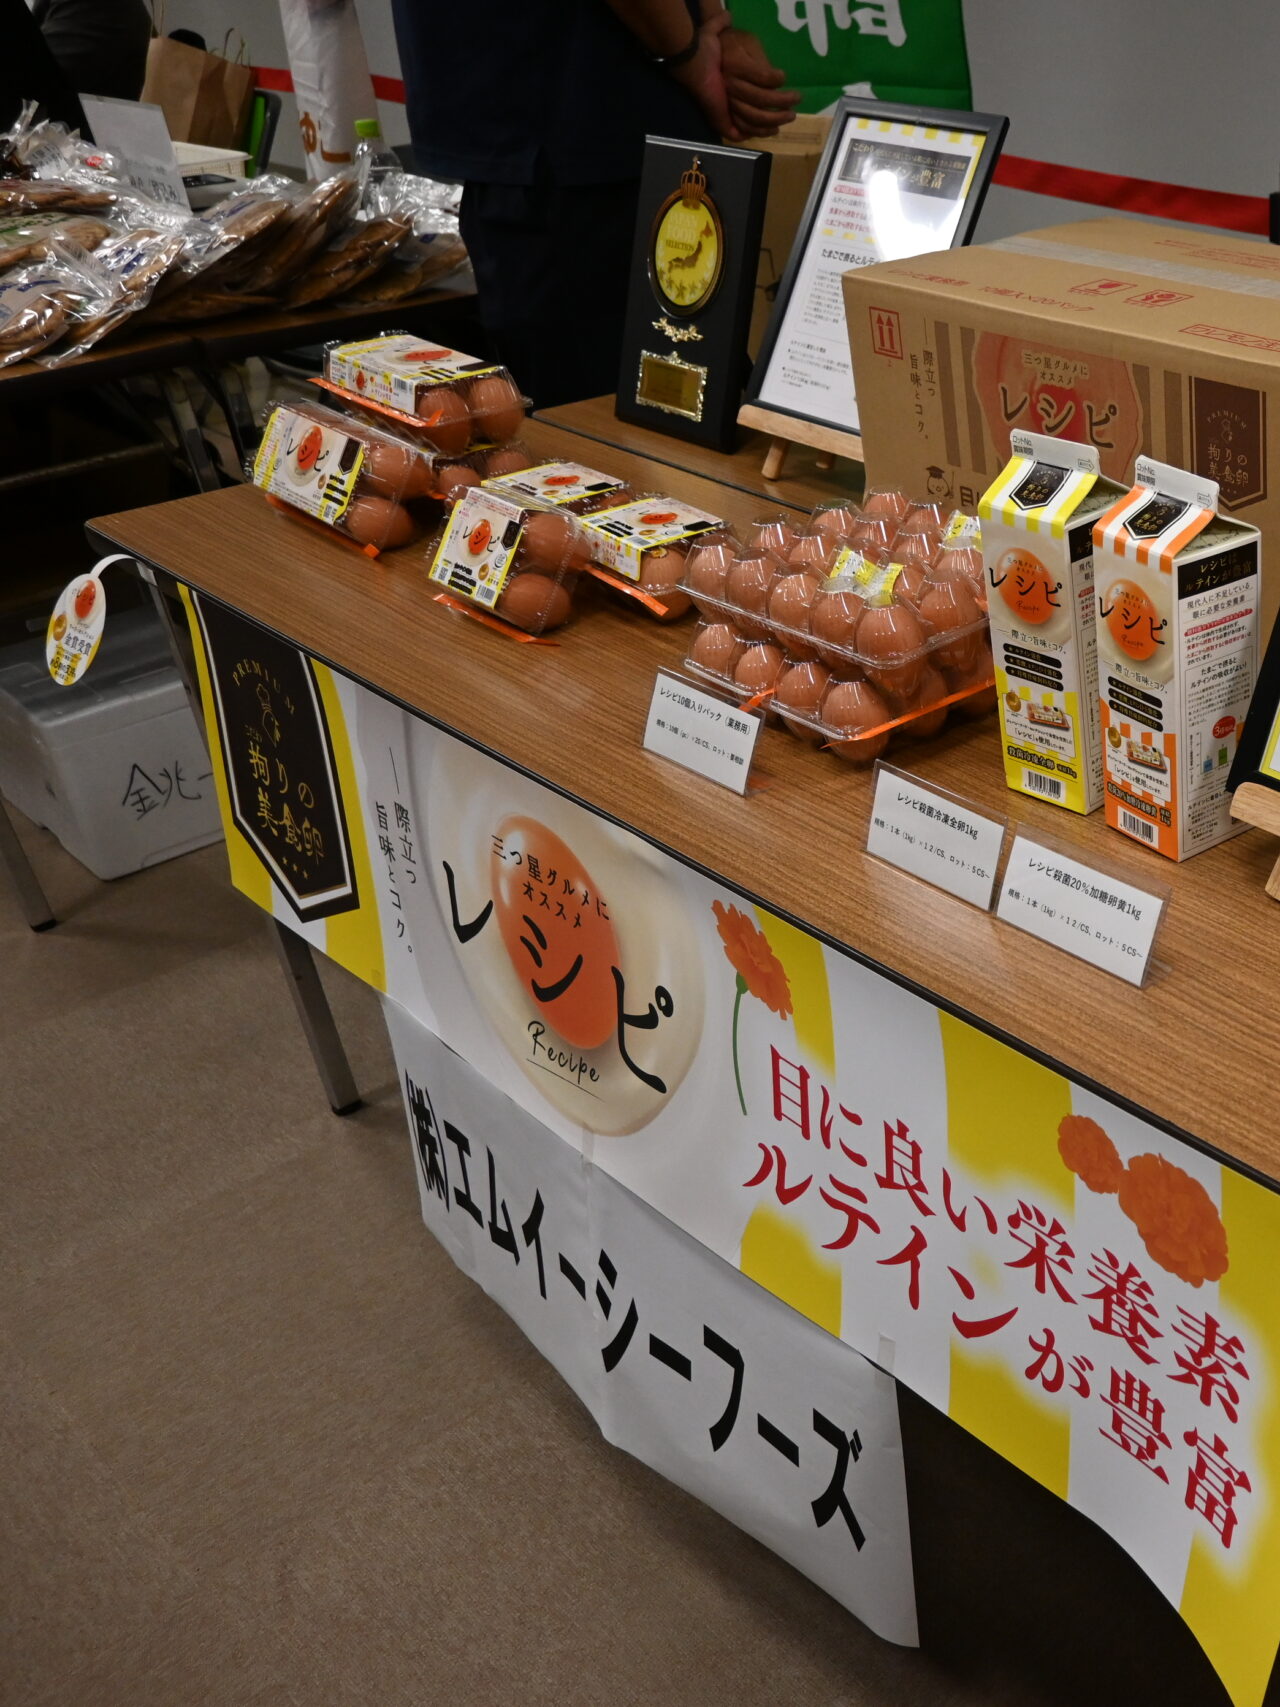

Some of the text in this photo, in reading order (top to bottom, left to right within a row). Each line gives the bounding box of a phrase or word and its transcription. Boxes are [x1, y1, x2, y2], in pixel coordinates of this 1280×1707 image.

[1023, 352, 1089, 378] 三つ星グルメに
[1039, 371, 1074, 387] オススメ
[1000, 386, 1118, 448] レシピ
[989, 567, 1063, 608] レシピ
[1187, 582, 1251, 609] 現代人に不足している
[1099, 596, 1168, 645] レシピ
[231, 657, 296, 717] PREMIUM
[247, 741, 316, 809] 拘りの
[896, 792, 980, 841] レシピ殺菌冷凍全卵1kg
[375, 801, 414, 954] 旨味とコク。
[490, 833, 611, 922] 三つ星グルメに
[521, 881, 583, 929] オススメ
[442, 860, 674, 1094] レシピ
[527, 1019, 602, 1085] Recipe
[769, 1043, 1252, 1424] 目に良い栄養素
[742, 1141, 1253, 1549] ルテインが豊富
